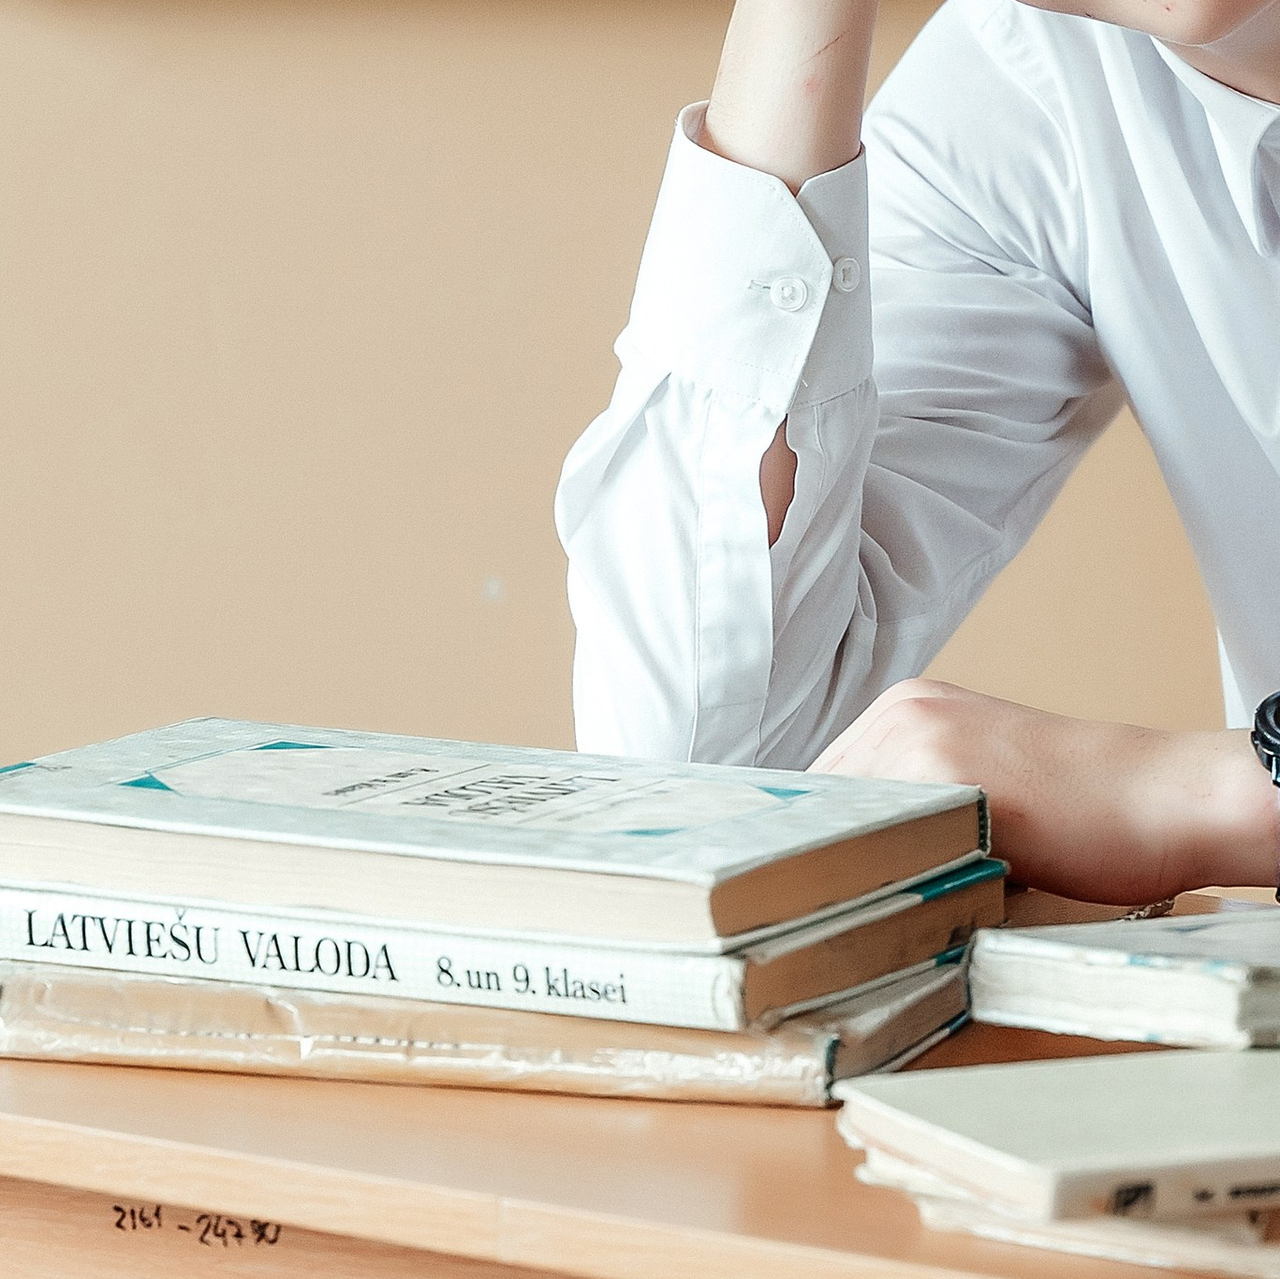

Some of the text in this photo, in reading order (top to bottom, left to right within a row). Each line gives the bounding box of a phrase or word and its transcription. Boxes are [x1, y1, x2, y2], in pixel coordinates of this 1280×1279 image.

[24, 908, 220, 965] LATVIEŠU
[238, 929, 400, 982] VALODA
[512, 963, 536, 995] 9.
[545, 966, 627, 1004] klasei
